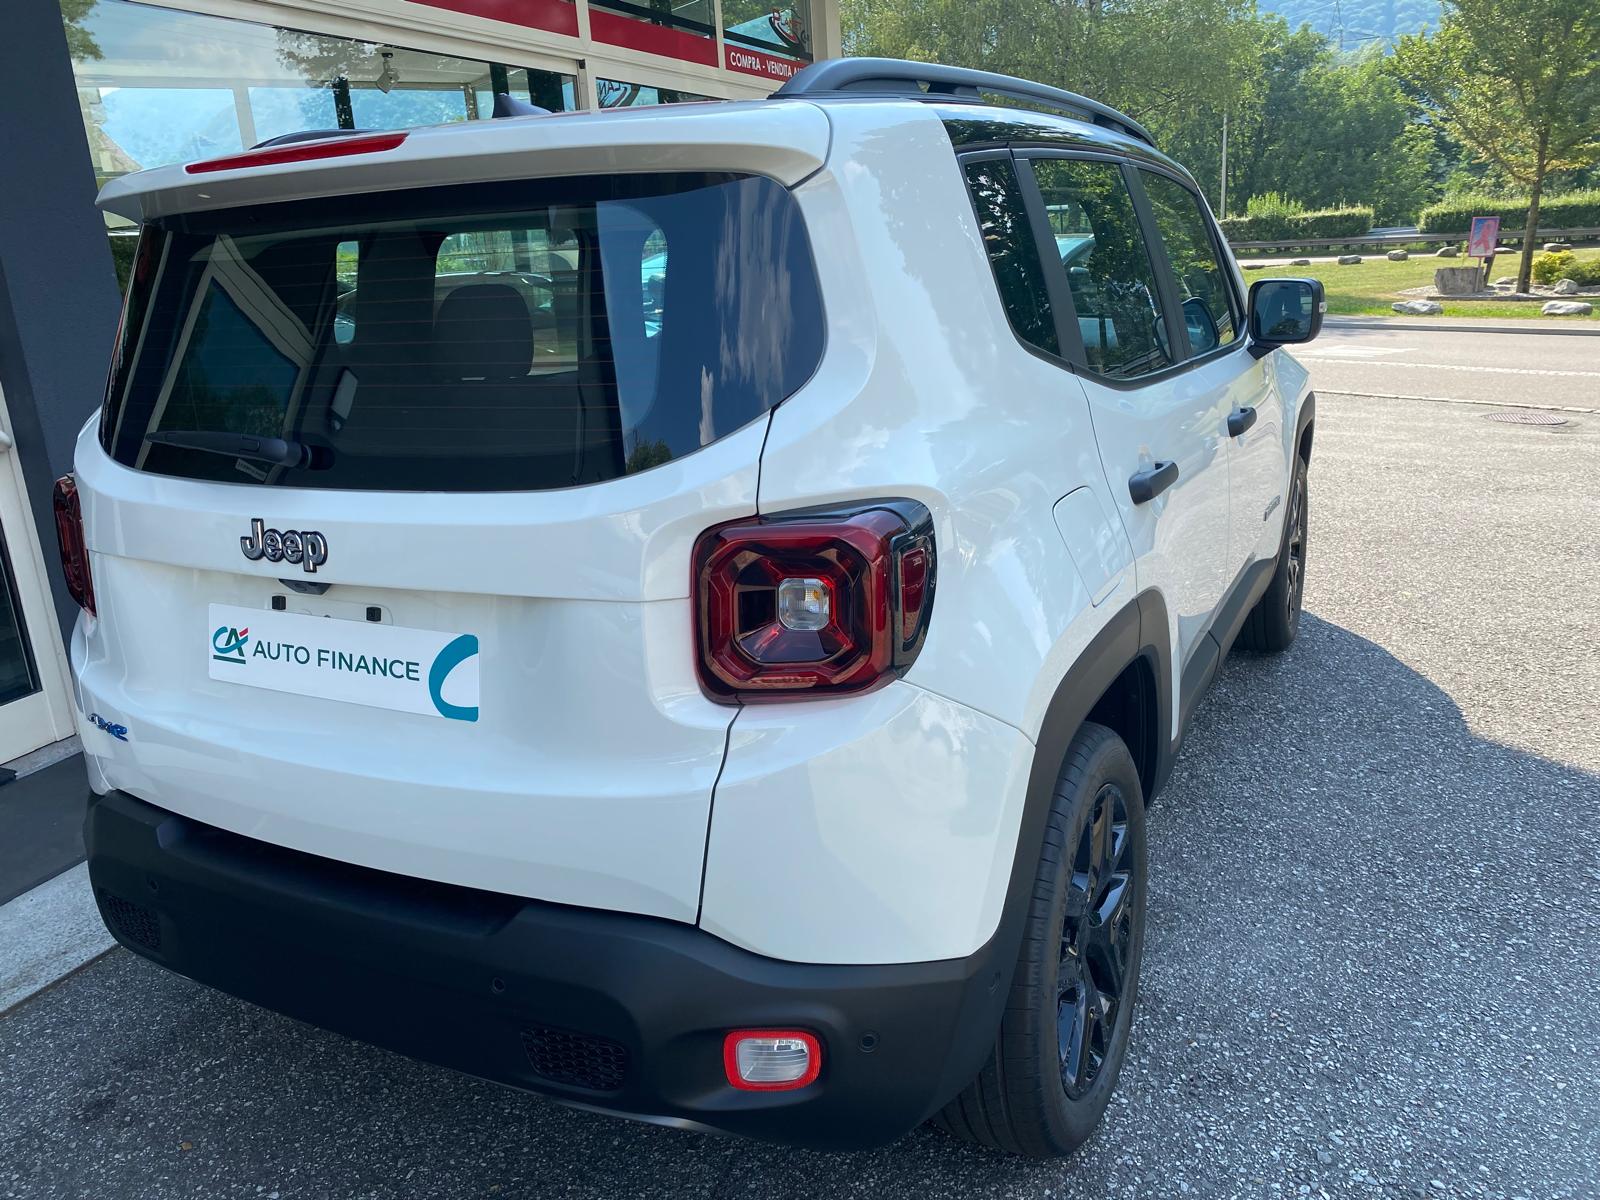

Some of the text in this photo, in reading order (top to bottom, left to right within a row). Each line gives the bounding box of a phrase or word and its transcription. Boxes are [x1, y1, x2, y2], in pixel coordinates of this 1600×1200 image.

[730, 52, 761, 71] COMPRA
[766, 60, 792, 77] VENDITA
[240, 518, 328, 573] Jeep
[252, 640, 311, 664] AUTO
[317, 648, 420, 682] FINANCE
